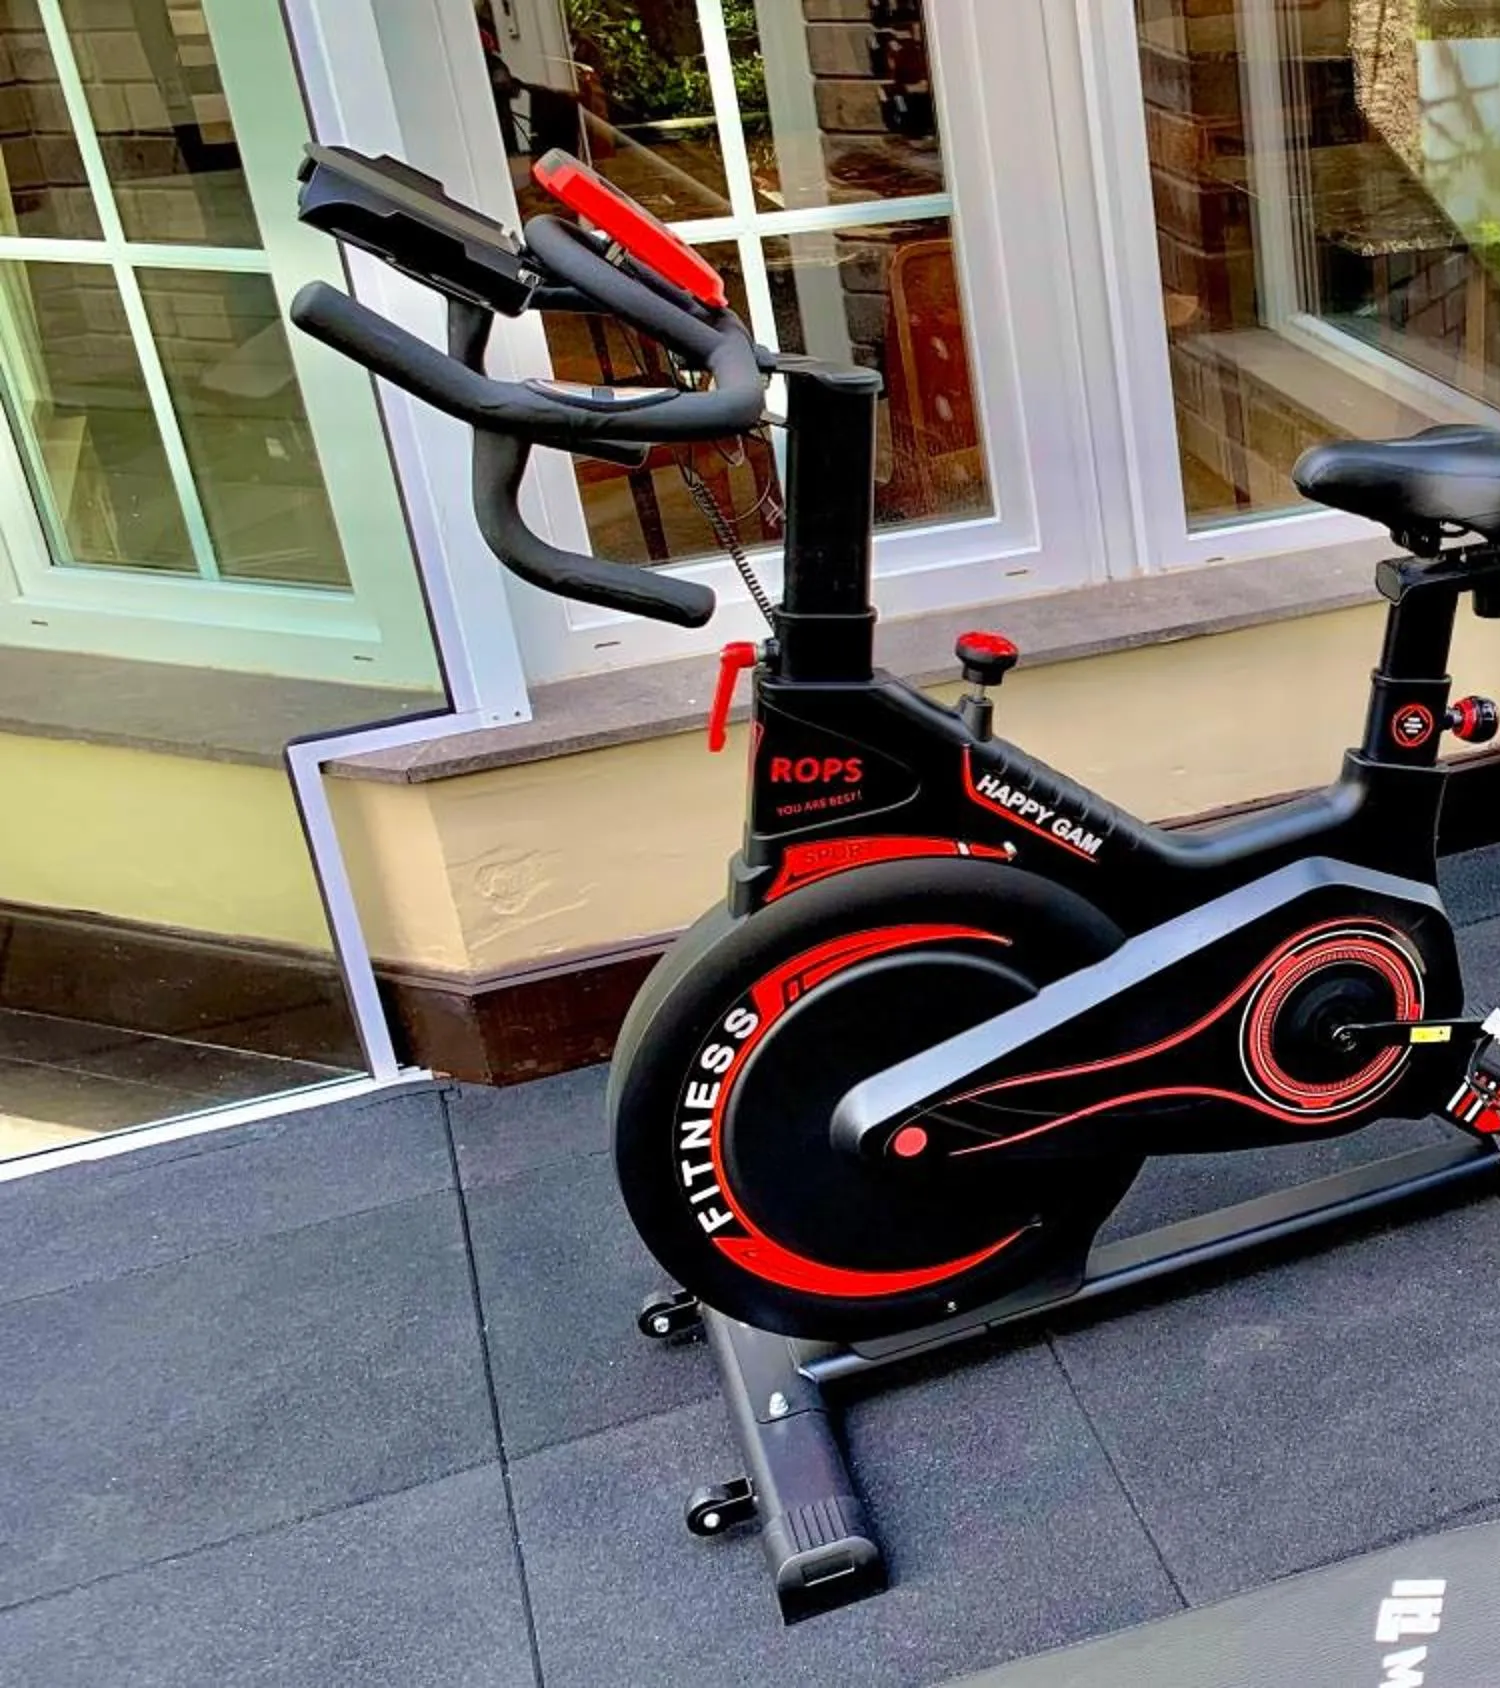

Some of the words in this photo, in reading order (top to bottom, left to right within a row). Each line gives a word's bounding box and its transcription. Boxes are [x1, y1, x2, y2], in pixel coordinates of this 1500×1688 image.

[770, 756, 863, 783] ROPS
[775, 803, 802, 817] YOU
[976, 774, 1055, 825] HAPPY
[1051, 818, 1103, 855] GAM
[679, 1007, 759, 1234] FITNESS
